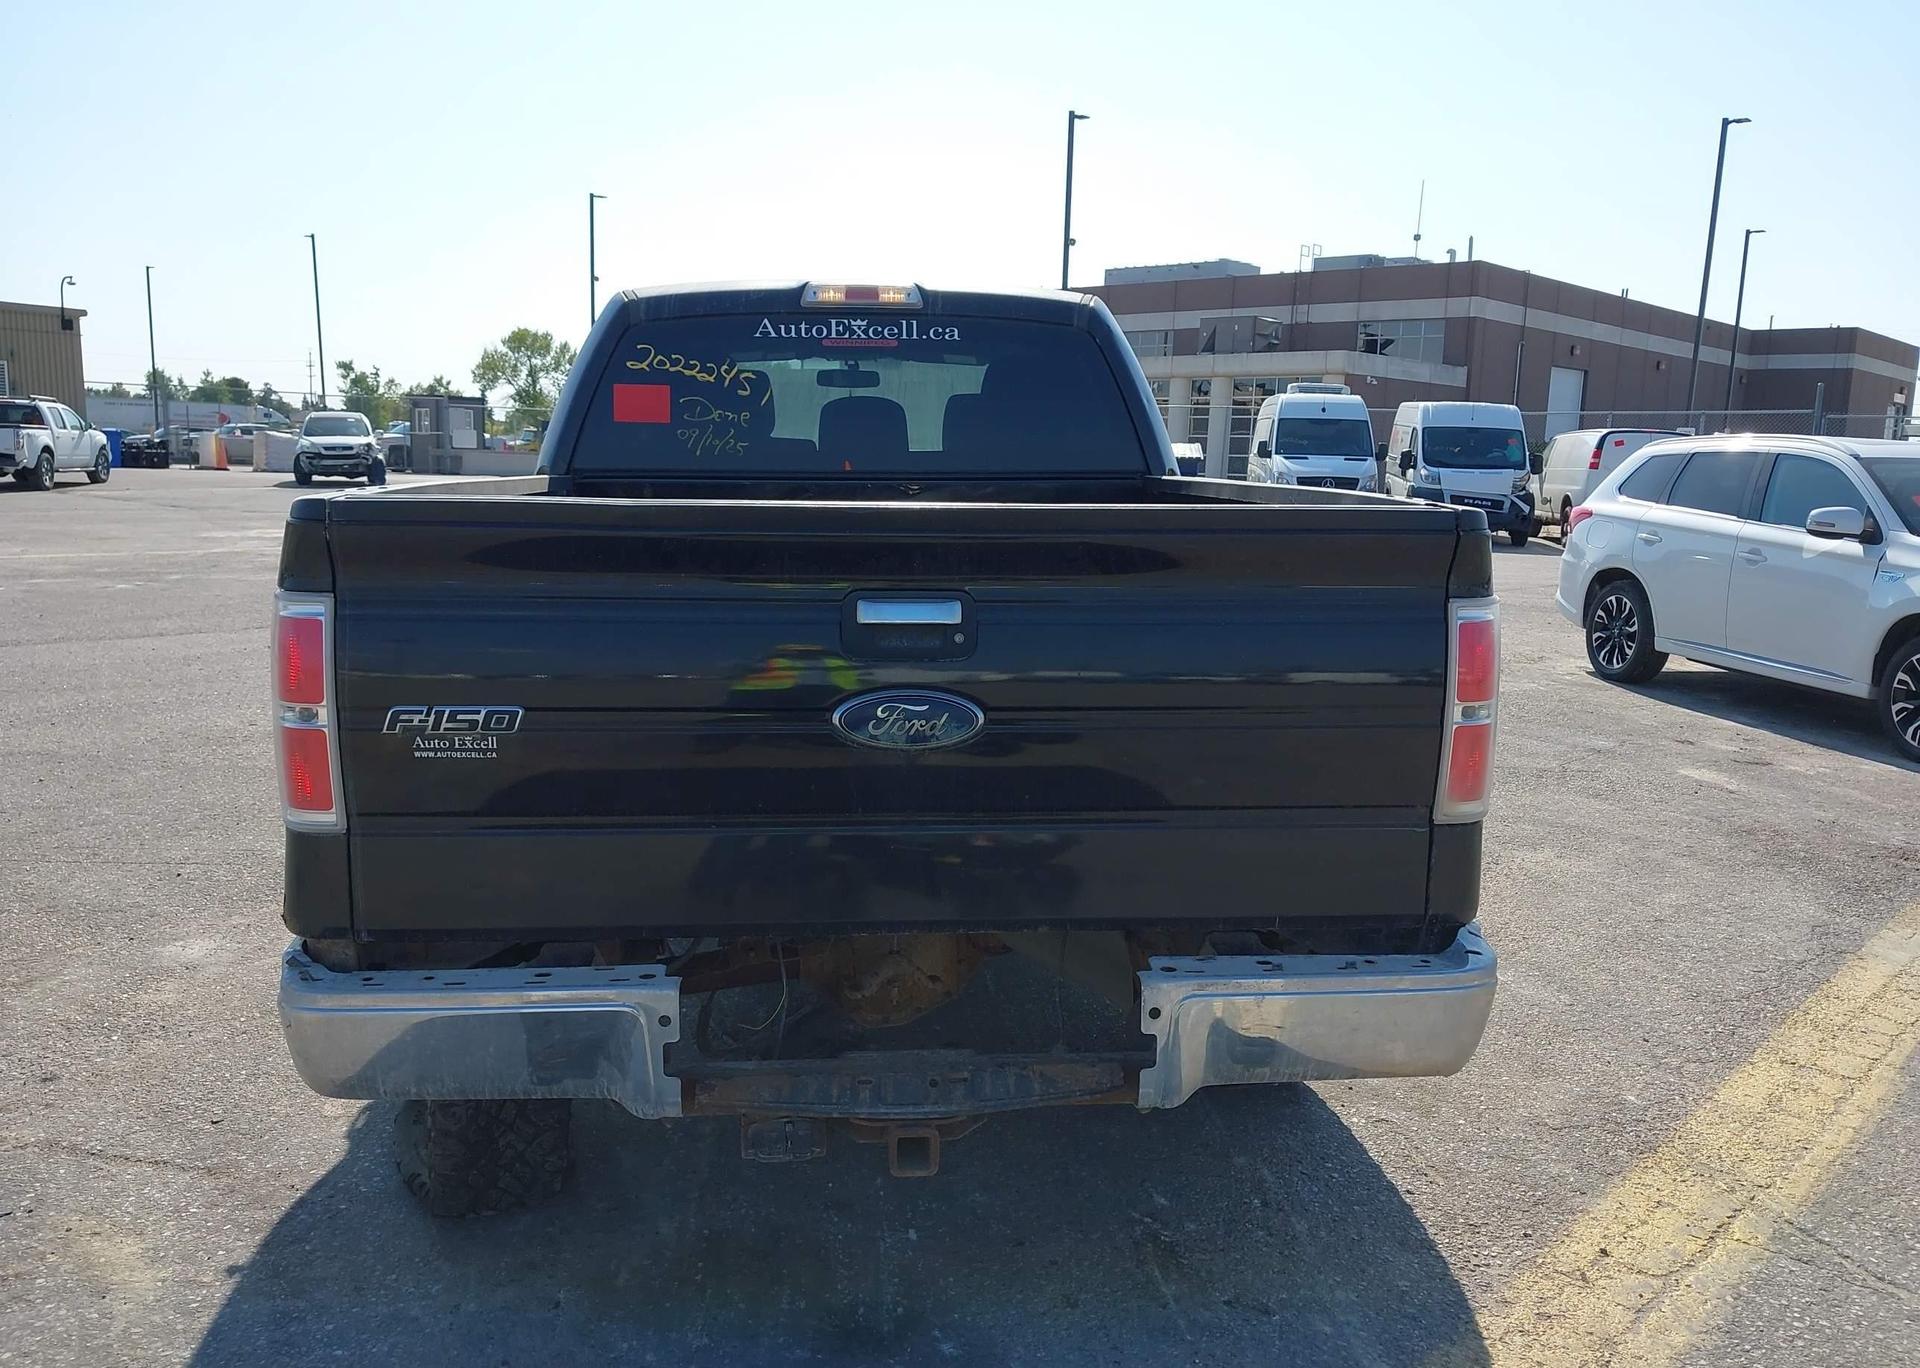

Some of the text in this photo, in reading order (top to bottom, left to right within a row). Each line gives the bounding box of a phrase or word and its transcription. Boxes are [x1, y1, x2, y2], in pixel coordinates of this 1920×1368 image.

[754, 318, 961, 341] AutoExcell.ca
[679, 396, 750, 427] Done
[381, 705, 525, 734] F-150
[868, 703, 950, 736] Ford
[412, 736, 498, 749] Auto Excell
